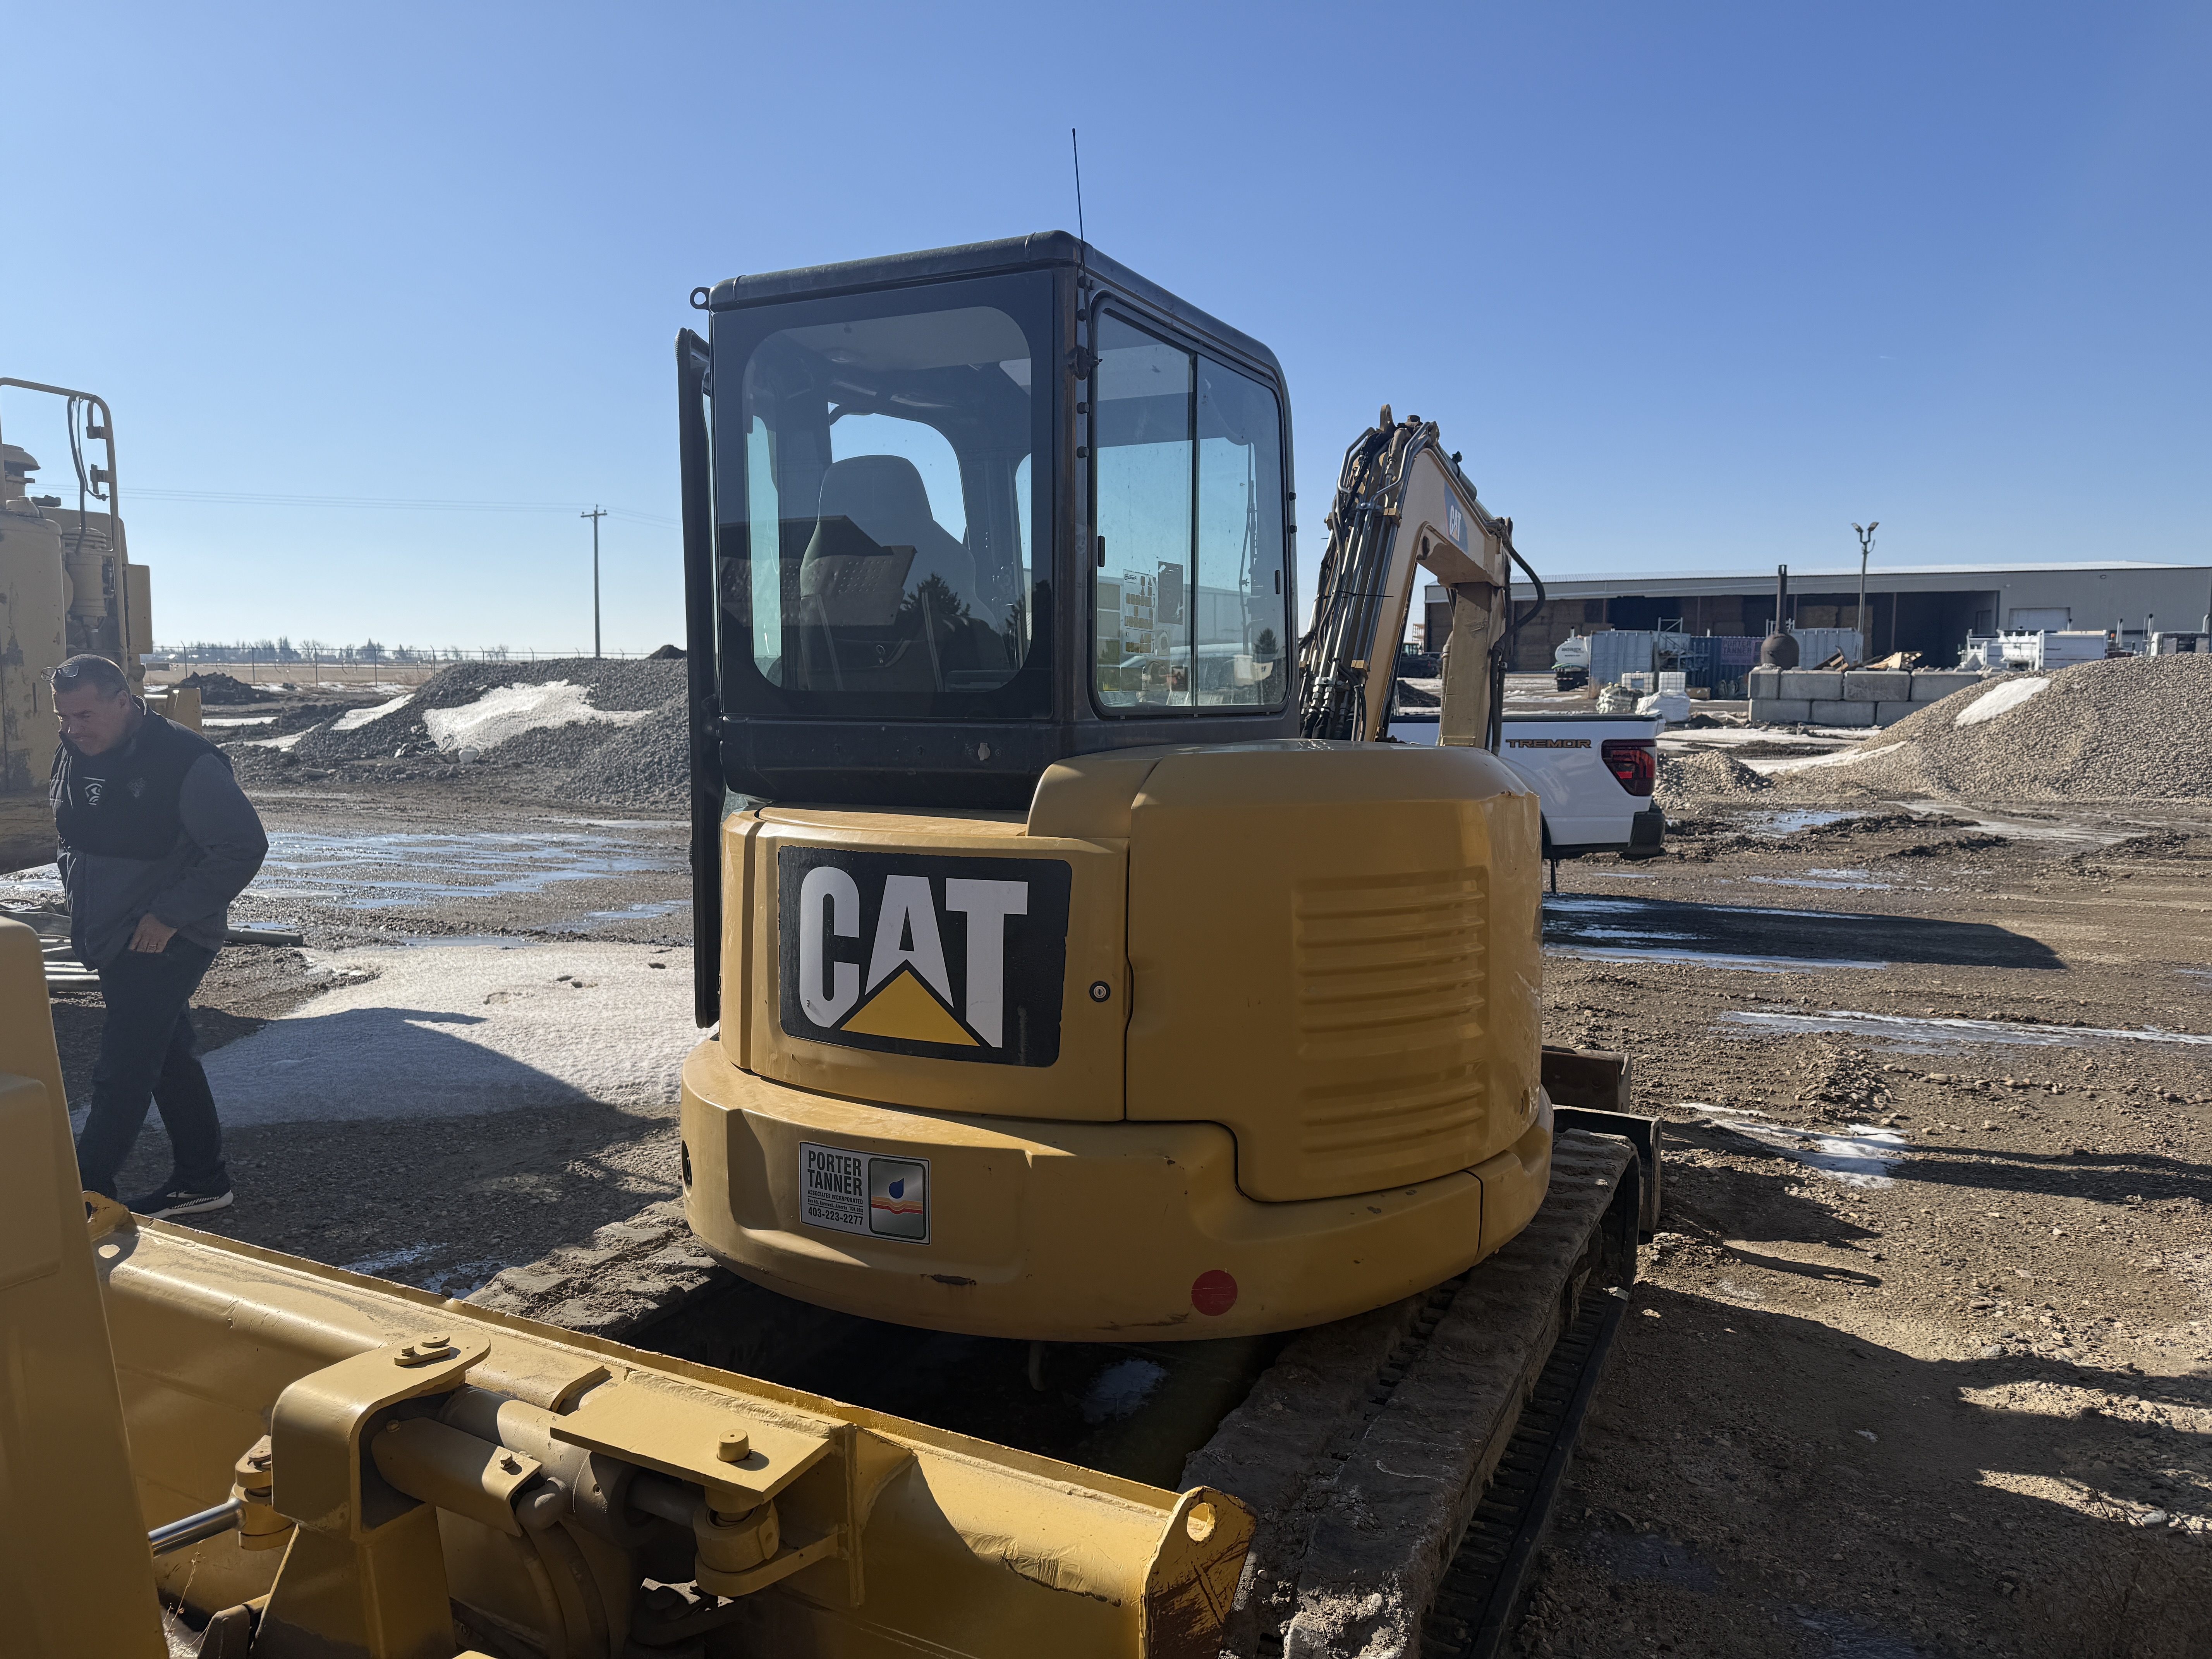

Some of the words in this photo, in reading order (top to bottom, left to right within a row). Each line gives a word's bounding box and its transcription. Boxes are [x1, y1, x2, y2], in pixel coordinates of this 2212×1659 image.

[1449, 505, 1462, 541] CAT
[1505, 739, 1592, 748] TREMOR
[799, 866, 1028, 1048] CAT
[808, 1150, 862, 1177] PORTER
[807, 1169, 862, 1196] TANNER
[808, 1189, 831, 1199] ASSOCIATES
[832, 1194, 863, 1204] INCORPORATED
[808, 1206, 863, 1226] 403-223-2277
